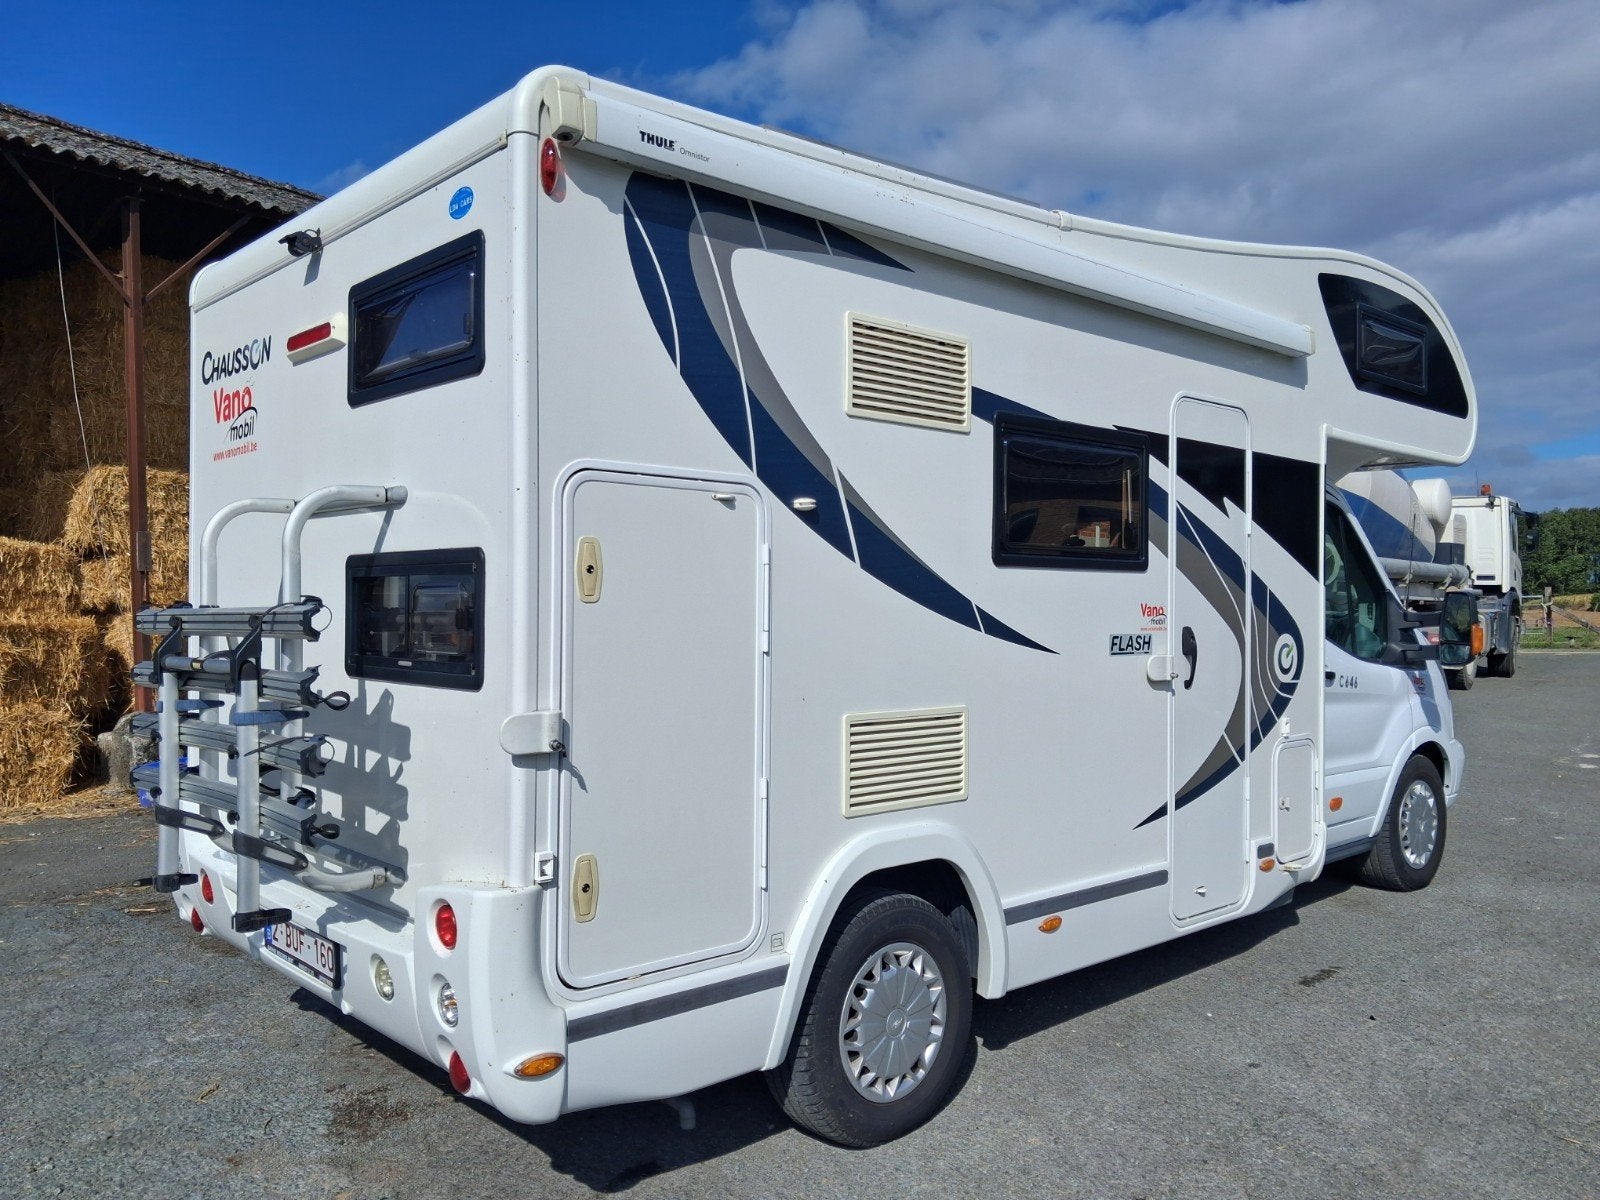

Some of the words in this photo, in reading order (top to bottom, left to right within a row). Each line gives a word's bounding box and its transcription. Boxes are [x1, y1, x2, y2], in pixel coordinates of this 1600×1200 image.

[639, 130, 675, 152] THULE
[680, 147, 710, 162] Omnistor
[201, 335, 271, 385] CHAUSSON
[213, 386, 252, 424] Vano
[230, 415, 255, 441] mobil
[213, 442, 257, 461] www.vanomobil.be
[1140, 603, 1164, 617] Vano
[1110, 634, 1152, 652] FLASH
